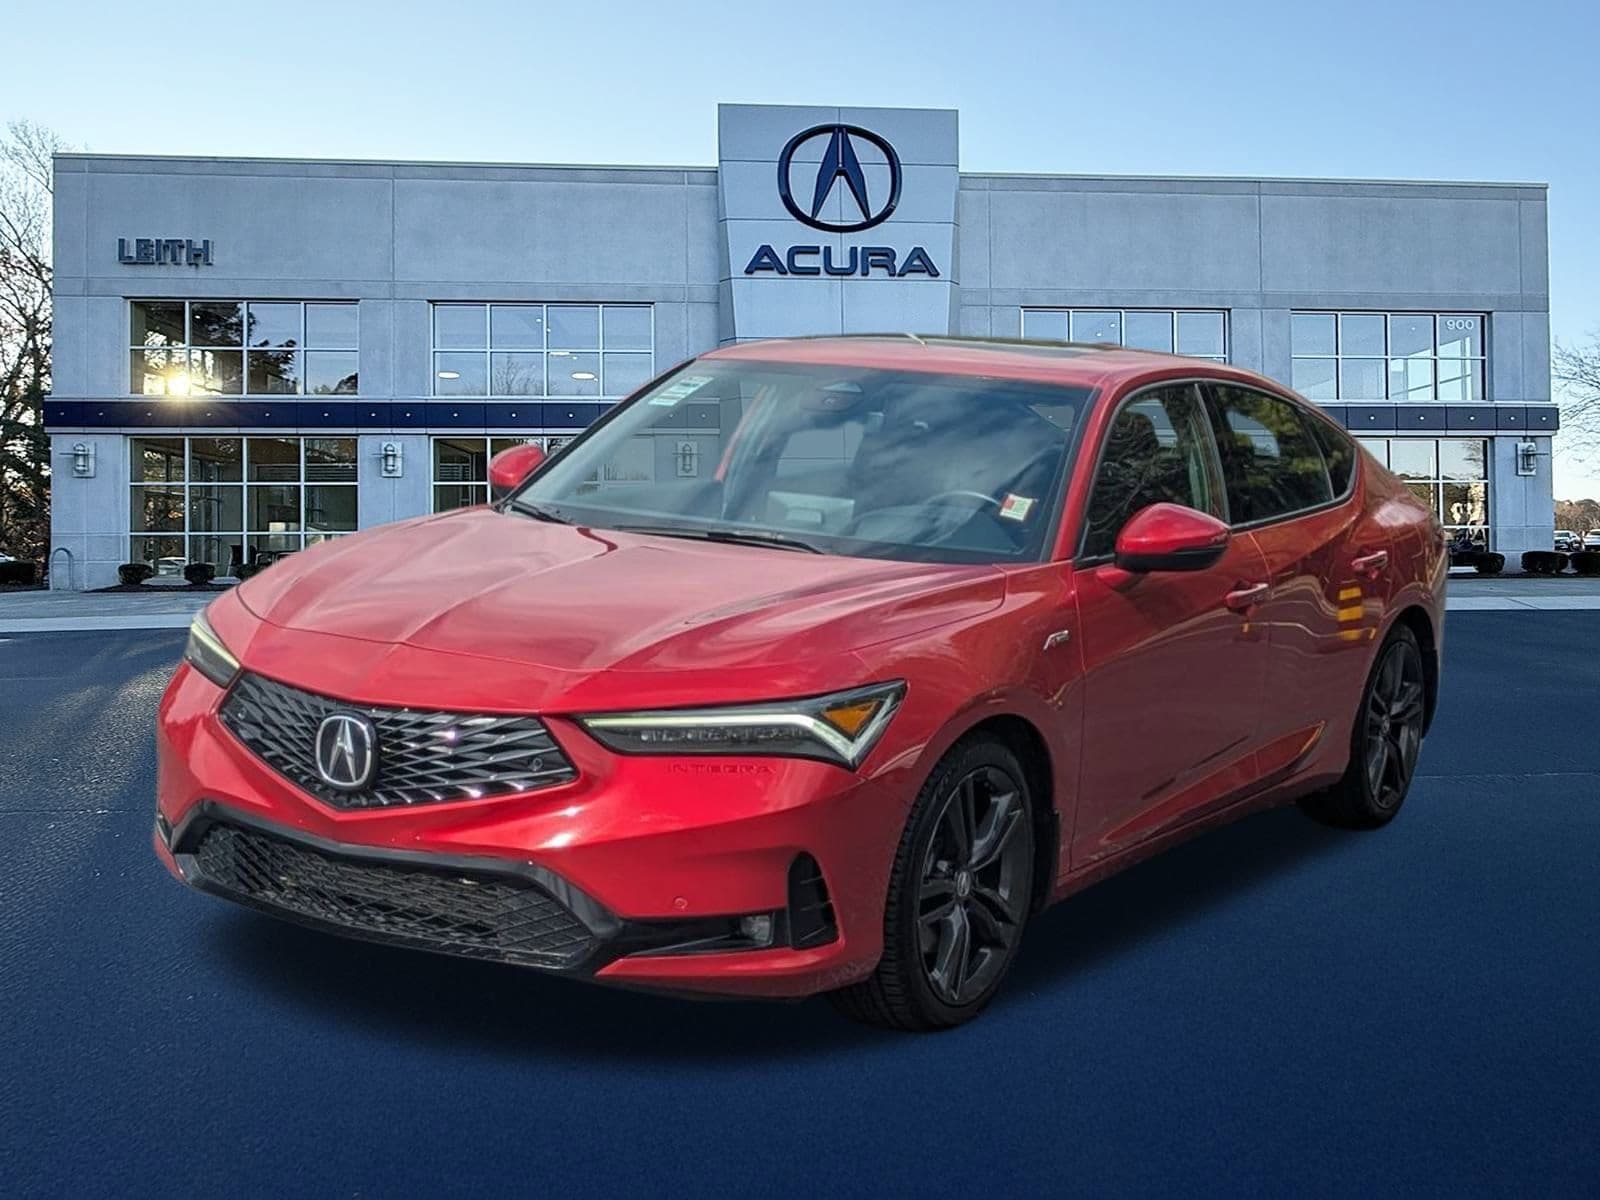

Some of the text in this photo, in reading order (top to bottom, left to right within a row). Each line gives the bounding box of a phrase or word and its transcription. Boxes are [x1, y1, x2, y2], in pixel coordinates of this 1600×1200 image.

[118, 238, 213, 265] LEITH
[744, 245, 940, 277] ACURA
[1446, 319, 1474, 330] 900
[665, 763, 776, 774] INTEGRA
